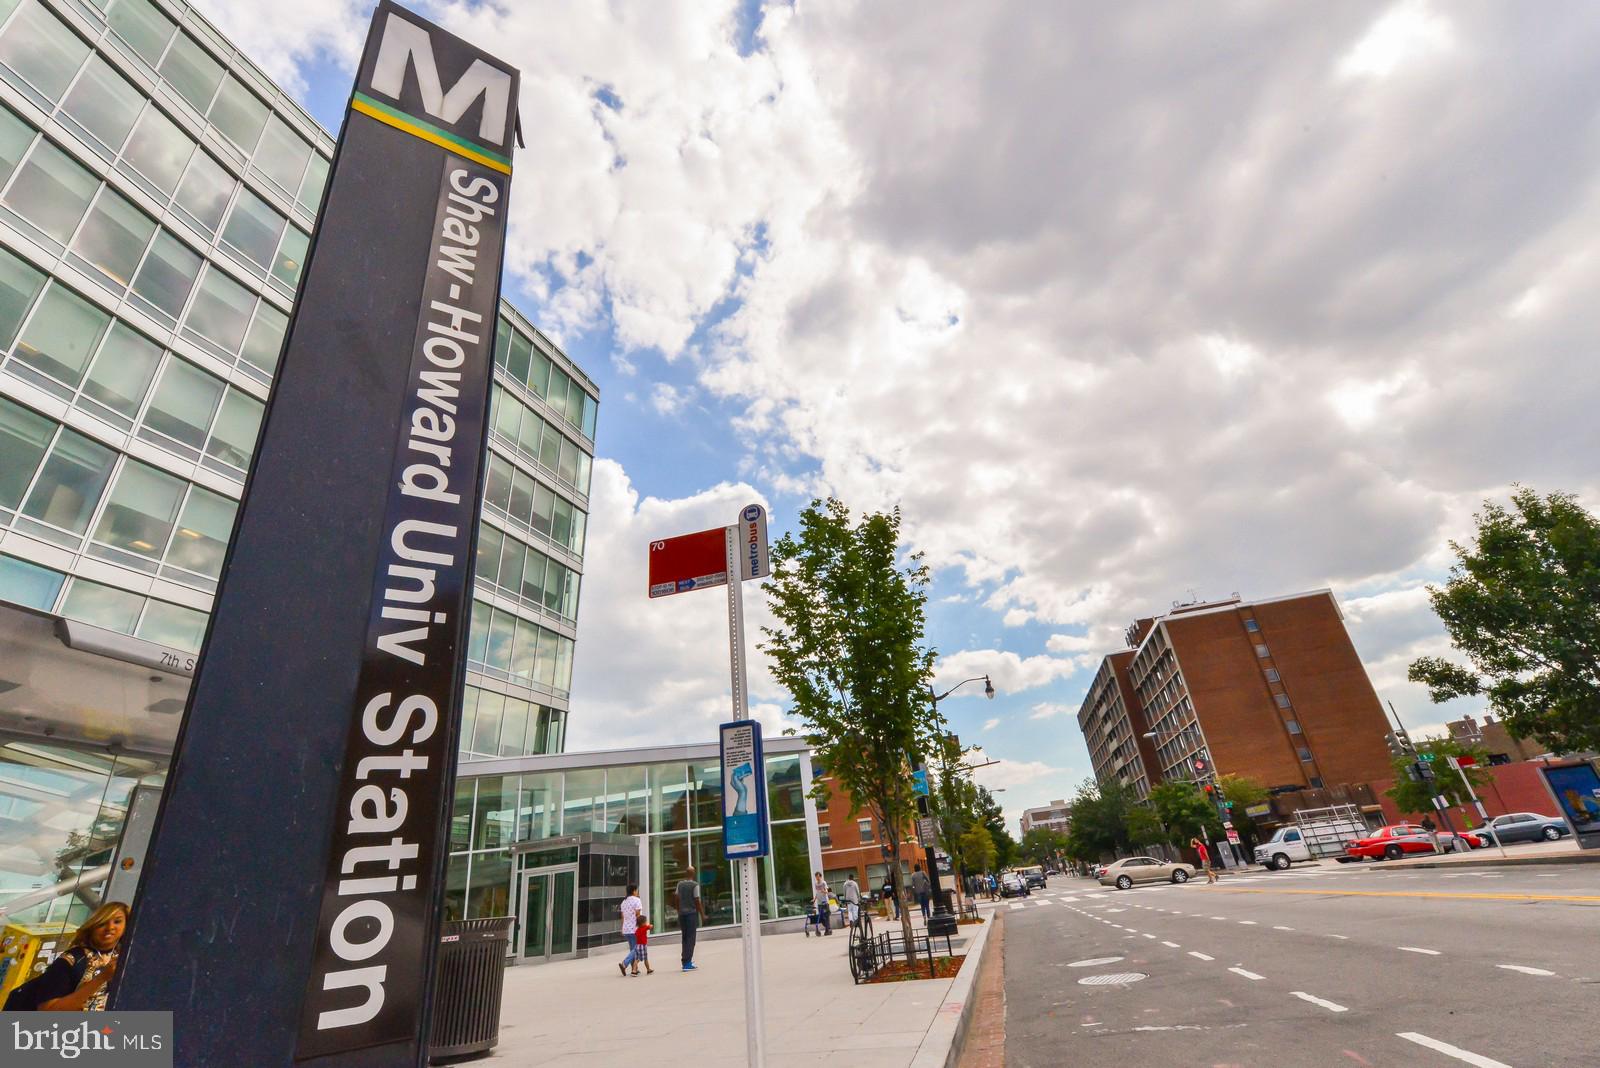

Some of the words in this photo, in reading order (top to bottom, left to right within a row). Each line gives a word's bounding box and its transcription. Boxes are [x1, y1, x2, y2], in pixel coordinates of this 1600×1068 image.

[370, 12, 512, 147] M
[401, 169, 499, 505] Shaw-Howard
[376, 519, 458, 667] Univ
[651, 541, 665, 552] 70
[747, 522, 760, 577] metrobus
[160, 651, 180, 668] 7th
[184, 658, 195, 671] S
[317, 692, 438, 1031] Station
